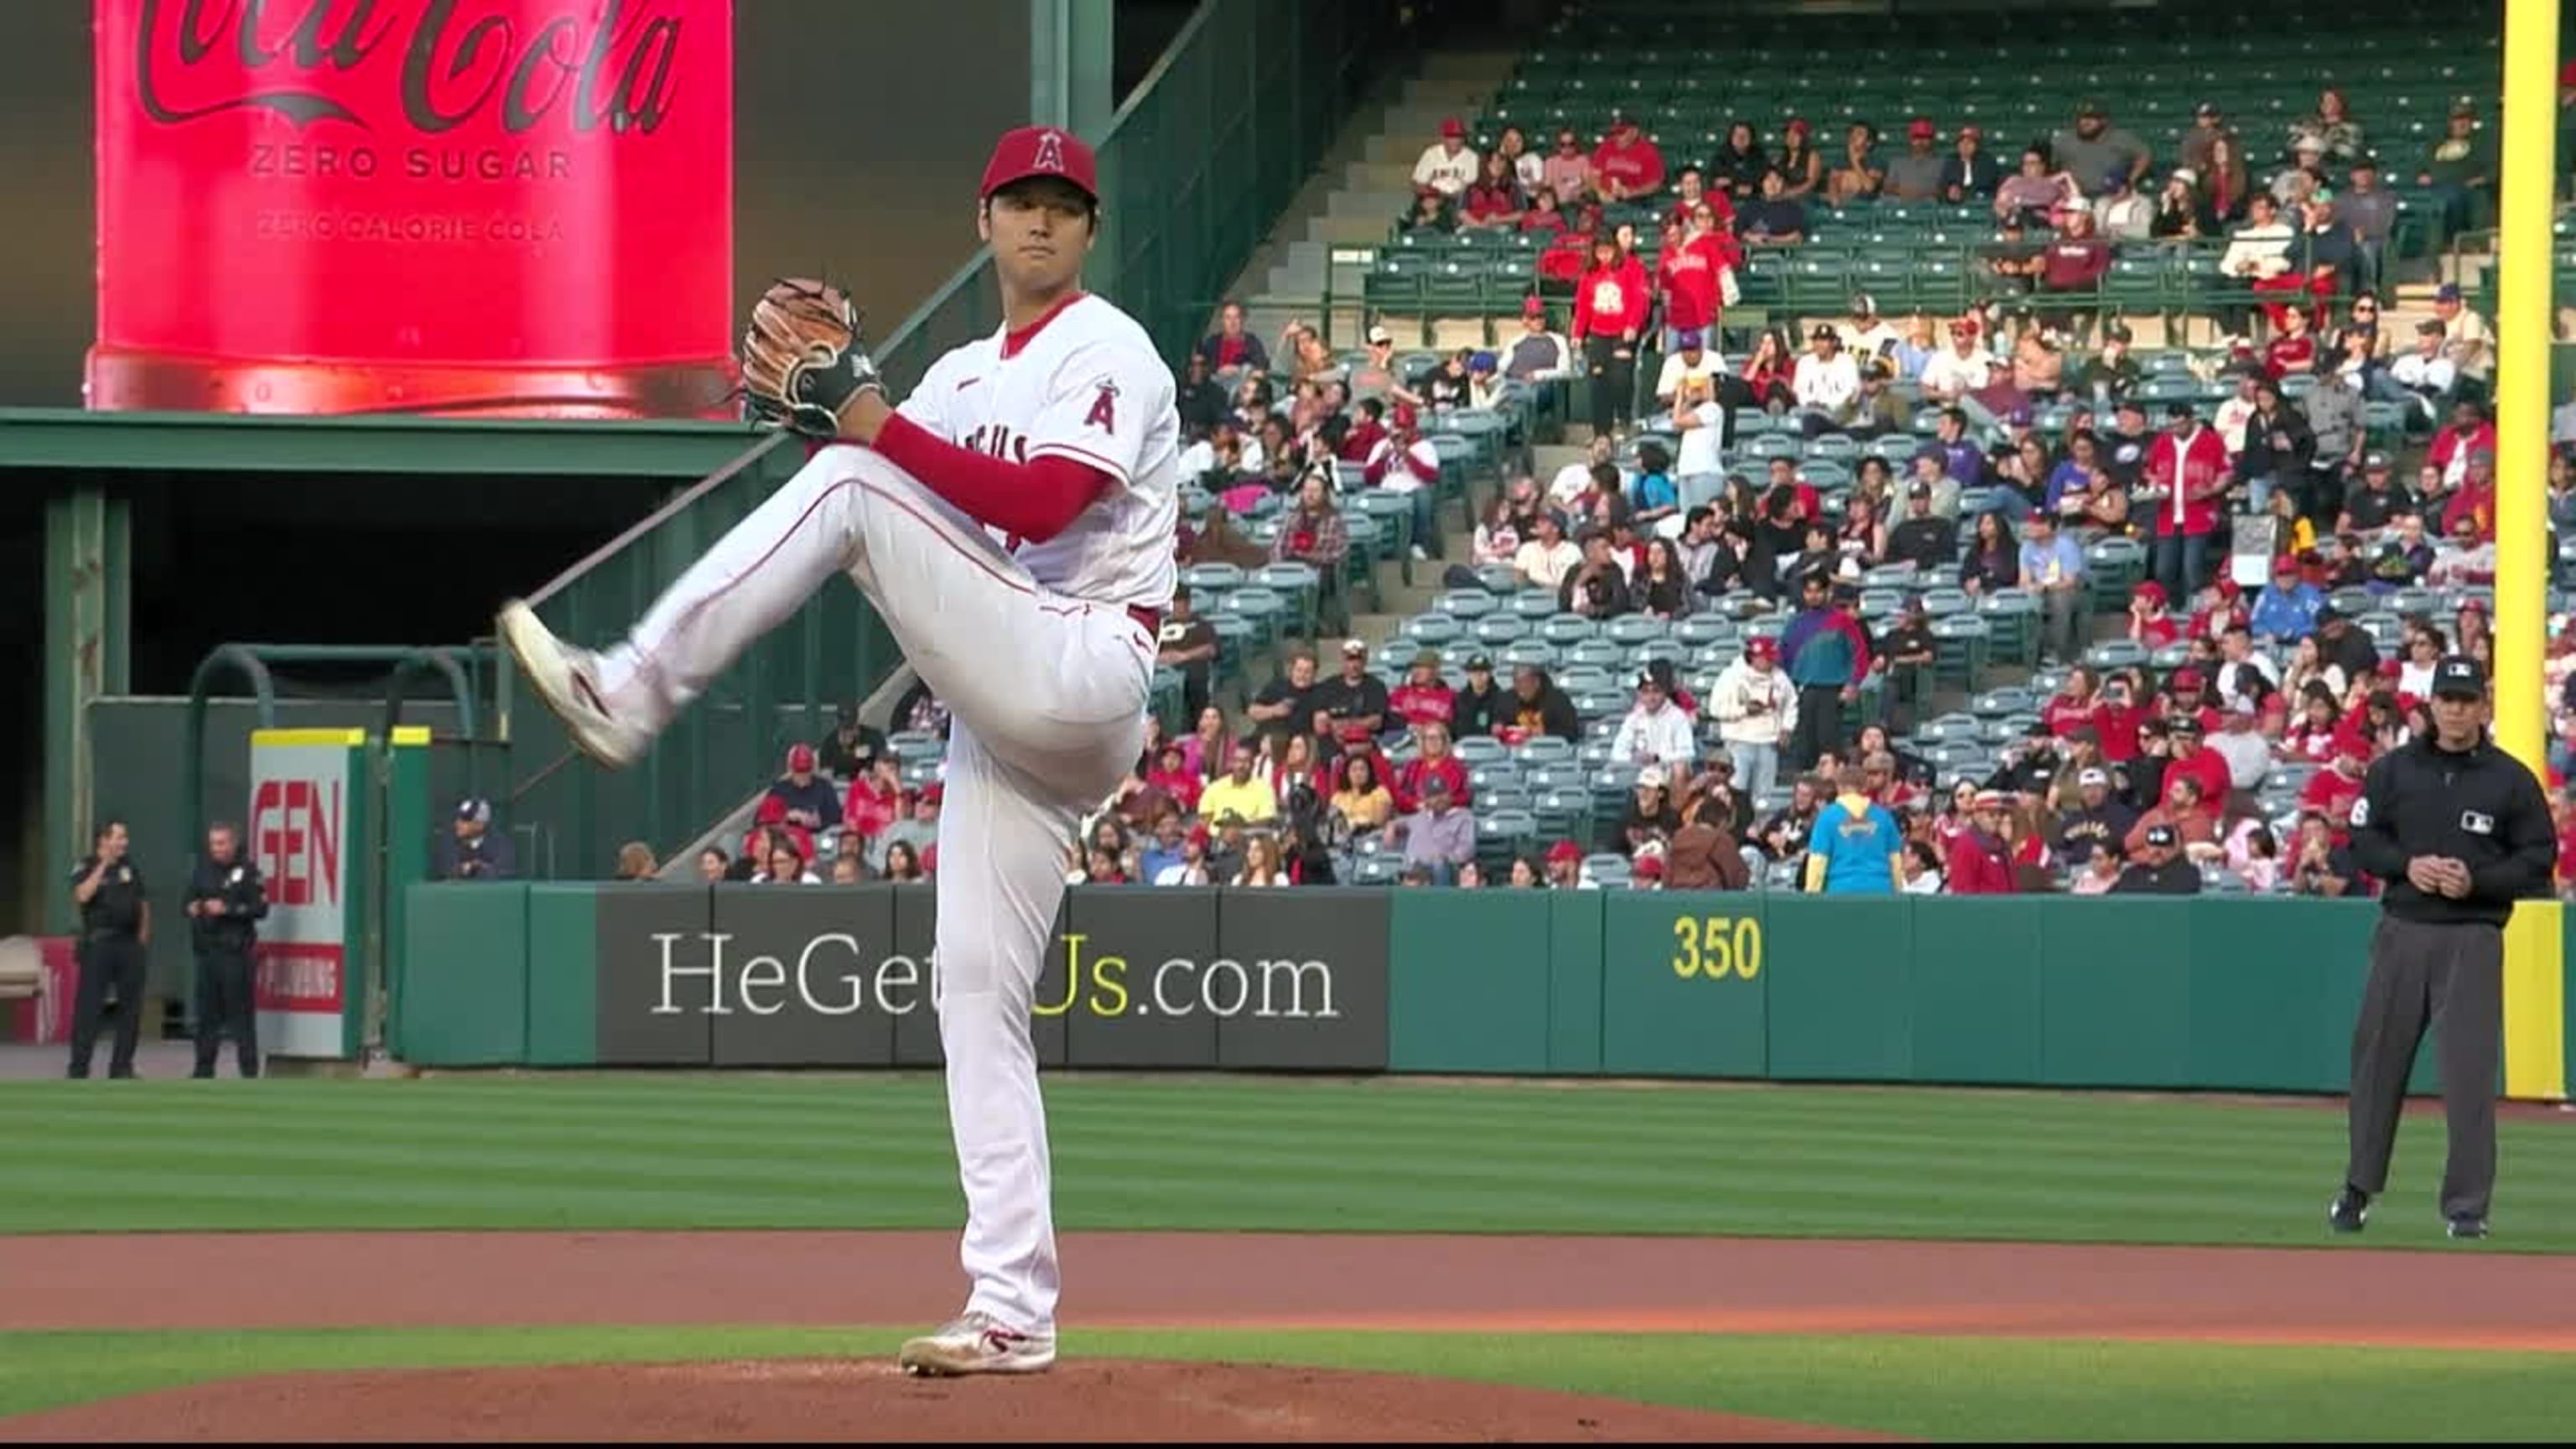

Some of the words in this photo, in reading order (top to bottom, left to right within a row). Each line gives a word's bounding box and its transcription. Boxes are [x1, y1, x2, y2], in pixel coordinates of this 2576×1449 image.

[252, 143, 378, 179] ZERO
[407, 148, 571, 179] SUGAR
[1034, 132, 1063, 172] A
[257, 211, 335, 240] ZERO
[340, 212, 478, 242] CALORIE
[486, 215, 565, 242] COLA
[1083, 385, 1114, 434] A
[1673, 916, 1761, 979] 350
